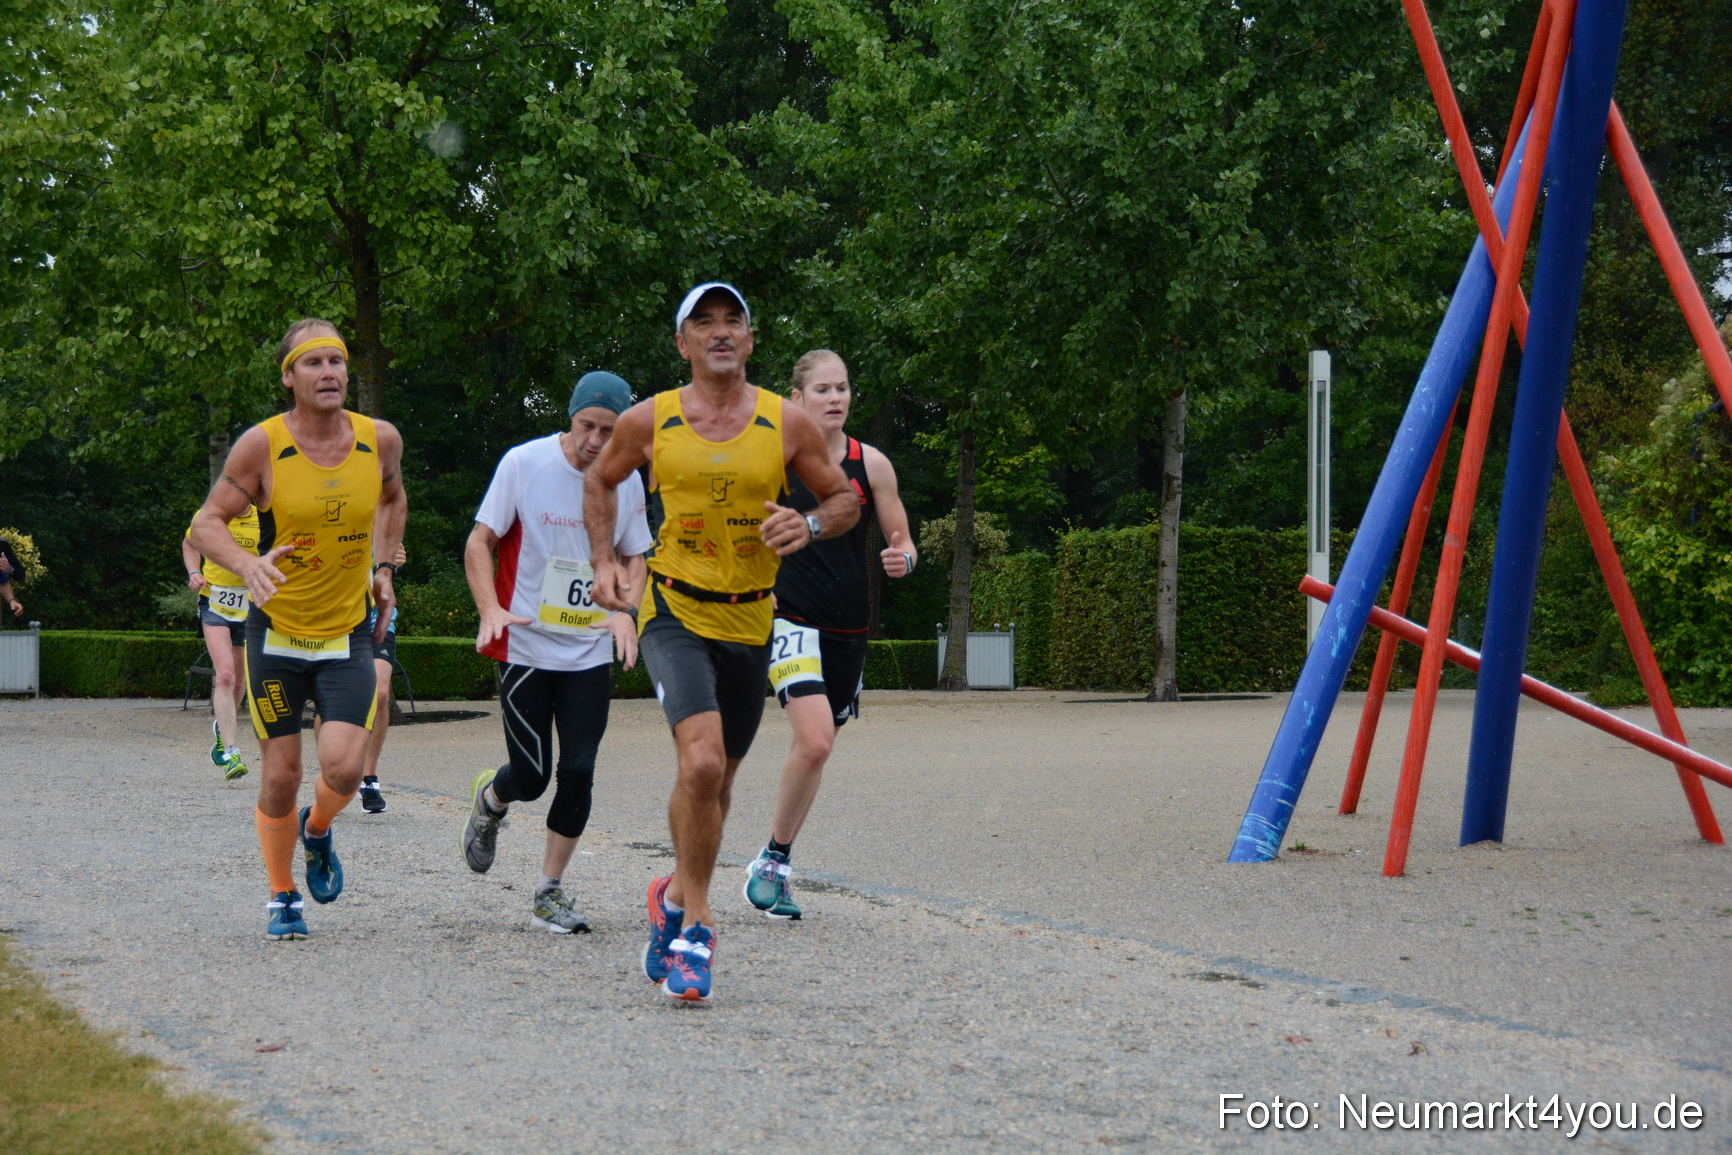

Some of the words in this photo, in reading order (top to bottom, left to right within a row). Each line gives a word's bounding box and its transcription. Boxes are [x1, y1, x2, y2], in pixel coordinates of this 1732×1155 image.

[679, 518, 704, 529] Seidl
[292, 537, 315, 547] Seidl
[219, 591, 244, 608] 231
[220, 607, 237, 617] Oliver
[559, 611, 593, 625] Roland
[289, 636, 326, 650] Helmut
[777, 663, 801, 679] Julia
[268, 684, 288, 713] Run!
